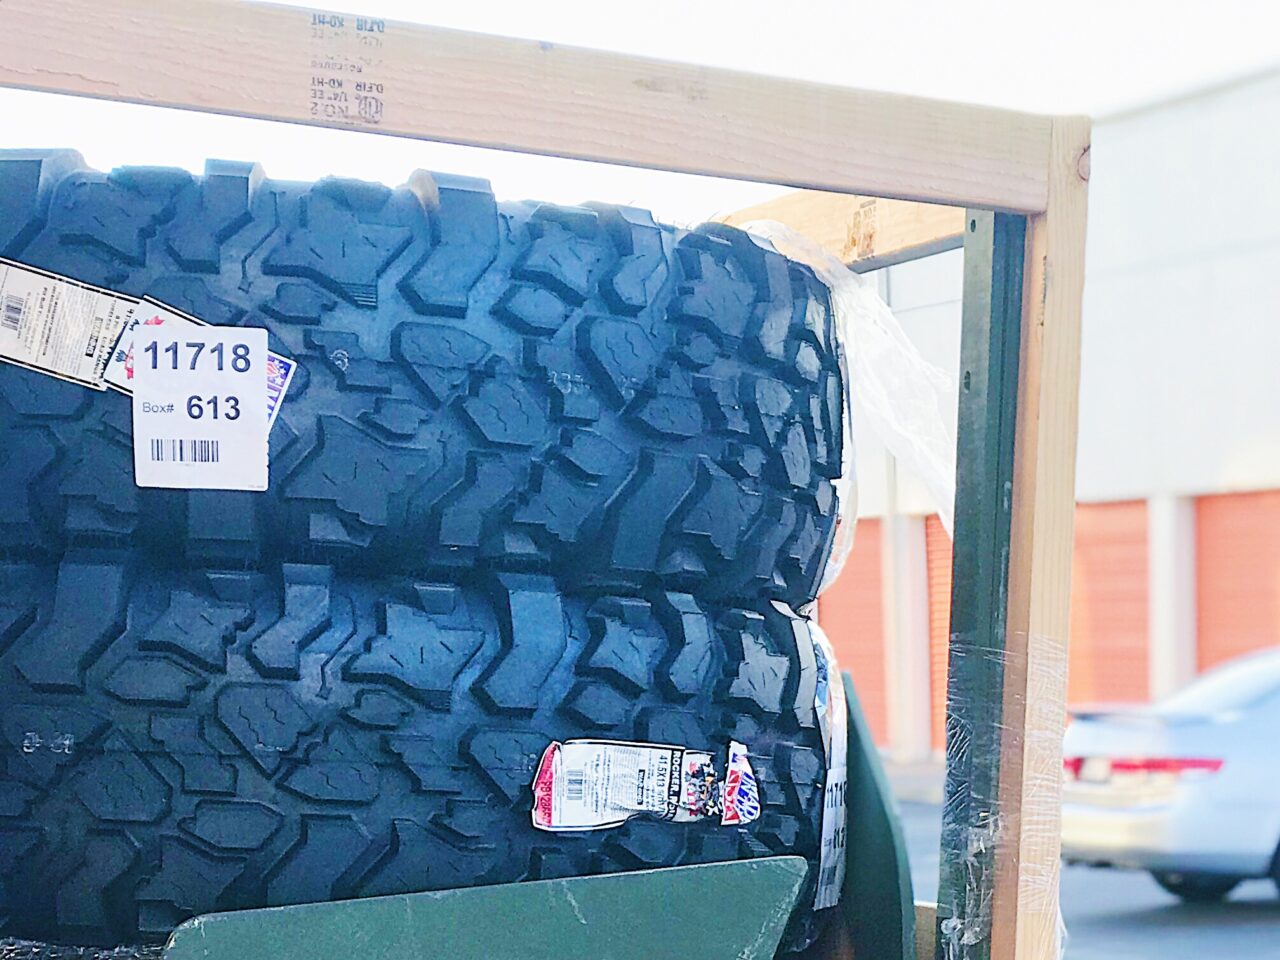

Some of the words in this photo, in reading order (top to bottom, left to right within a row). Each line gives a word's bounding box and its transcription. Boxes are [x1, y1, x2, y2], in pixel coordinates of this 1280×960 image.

[144, 341, 251, 373] 11718
[142, 402, 175, 413] Box#
[186, 395, 241, 421] 613
